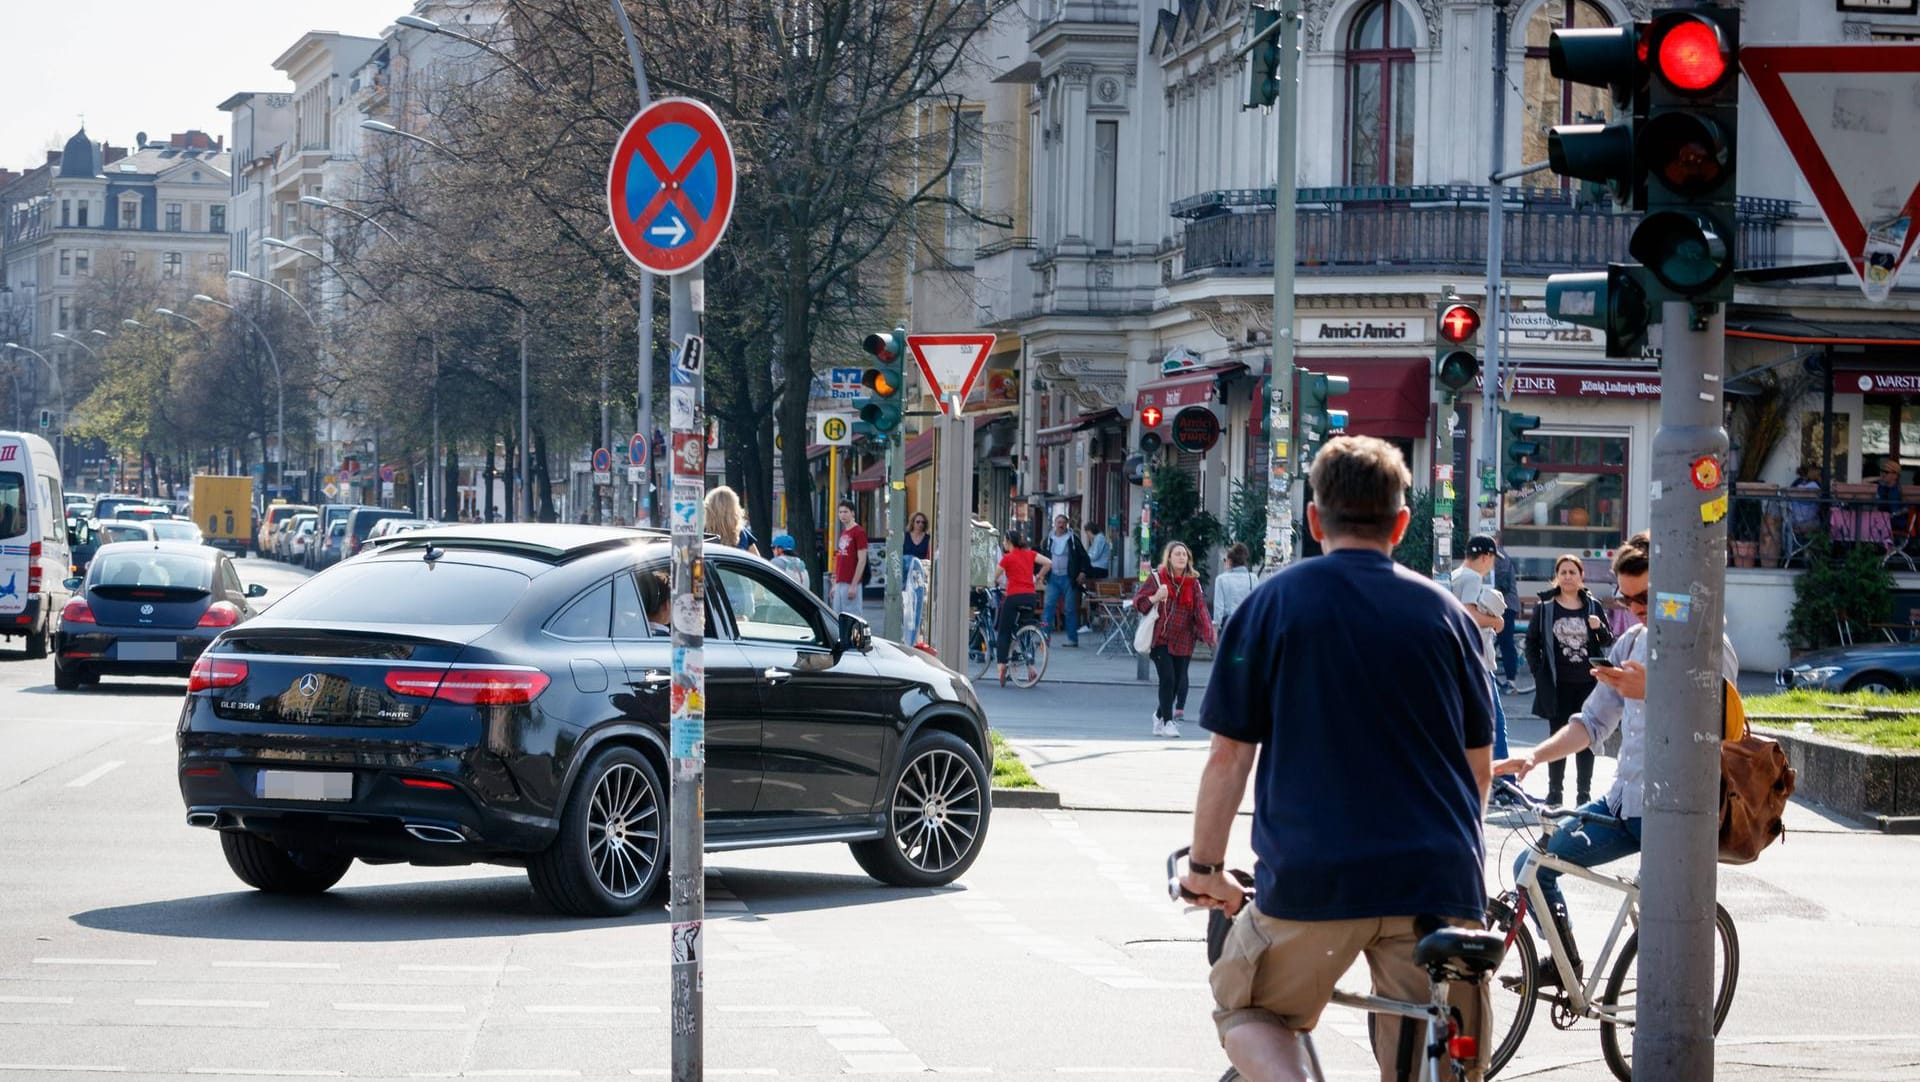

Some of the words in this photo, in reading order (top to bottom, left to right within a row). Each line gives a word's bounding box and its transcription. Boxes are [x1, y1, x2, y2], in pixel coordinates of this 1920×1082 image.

[1319, 322, 1361, 338] Amici
[1363, 322, 1406, 338] Amici
[832, 389, 861, 399] Bank
[220, 700, 237, 710] GLE
[238, 702, 261, 711] 350d
[377, 710, 409, 719] 4MATIC
